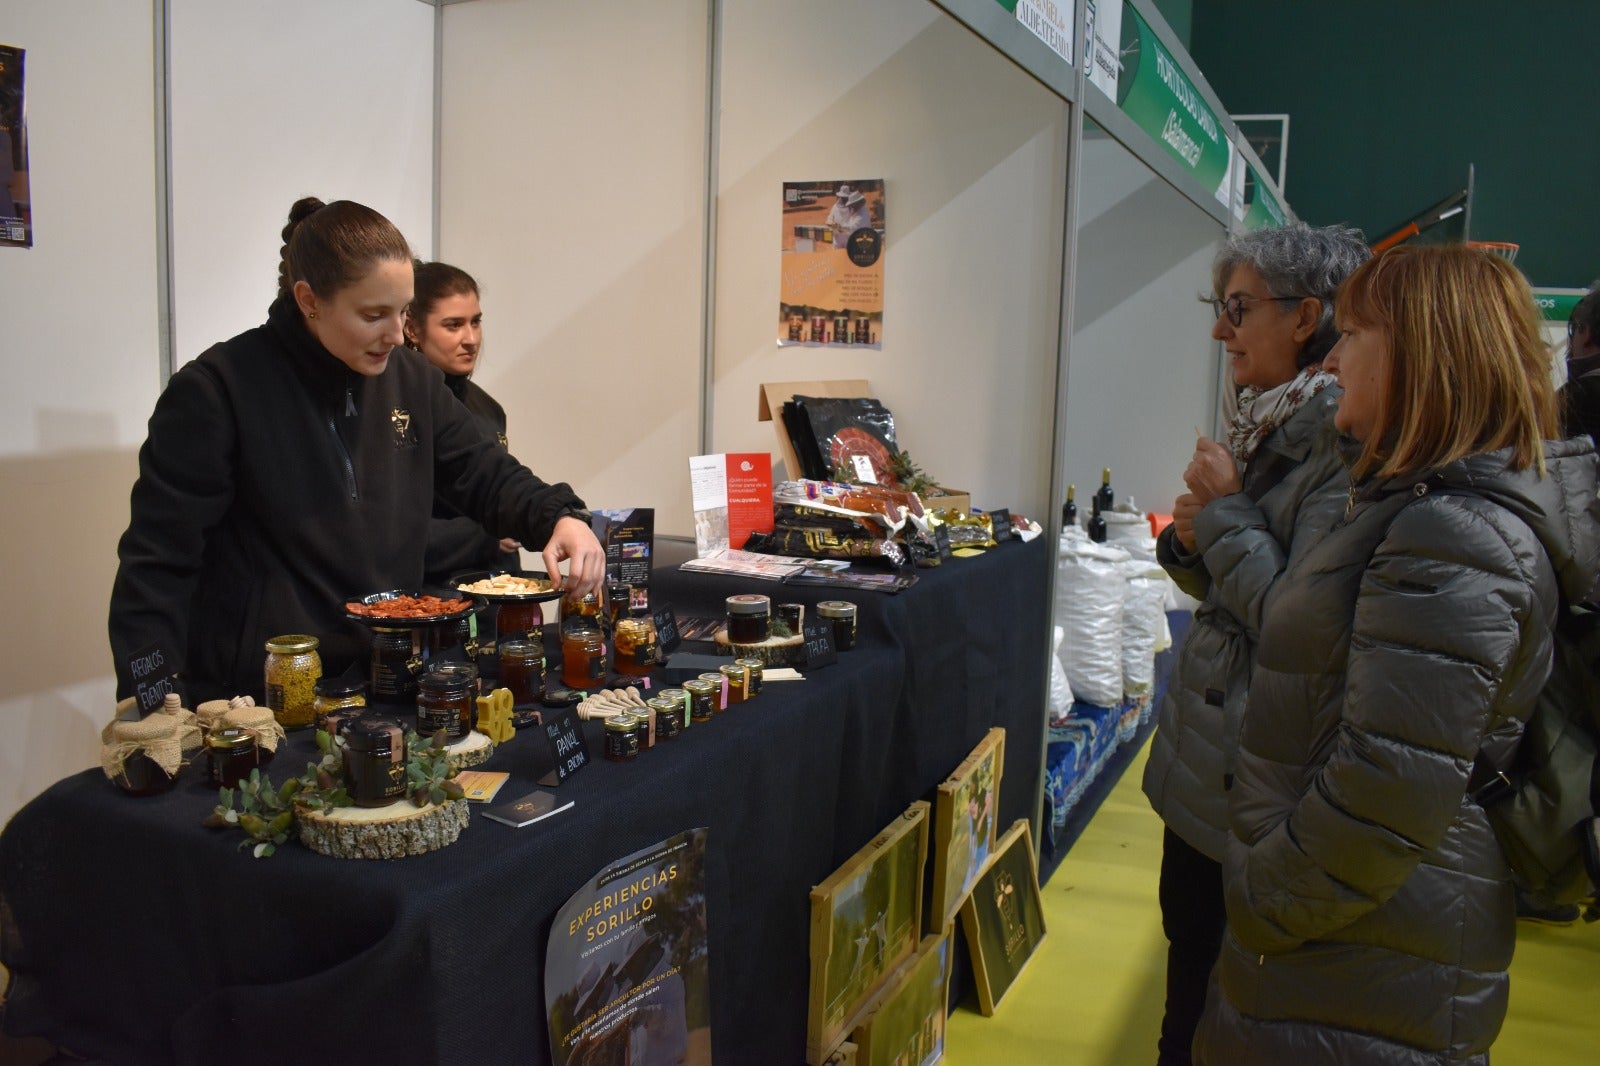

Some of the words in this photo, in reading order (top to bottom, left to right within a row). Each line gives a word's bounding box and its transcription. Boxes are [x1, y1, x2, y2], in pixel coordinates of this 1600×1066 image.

[131, 650, 164, 679] REGALOS
[569, 865, 677, 936] EXPERIENCIAS
[587, 896, 653, 942] SORILLO
[642, 978, 655, 989] POR
